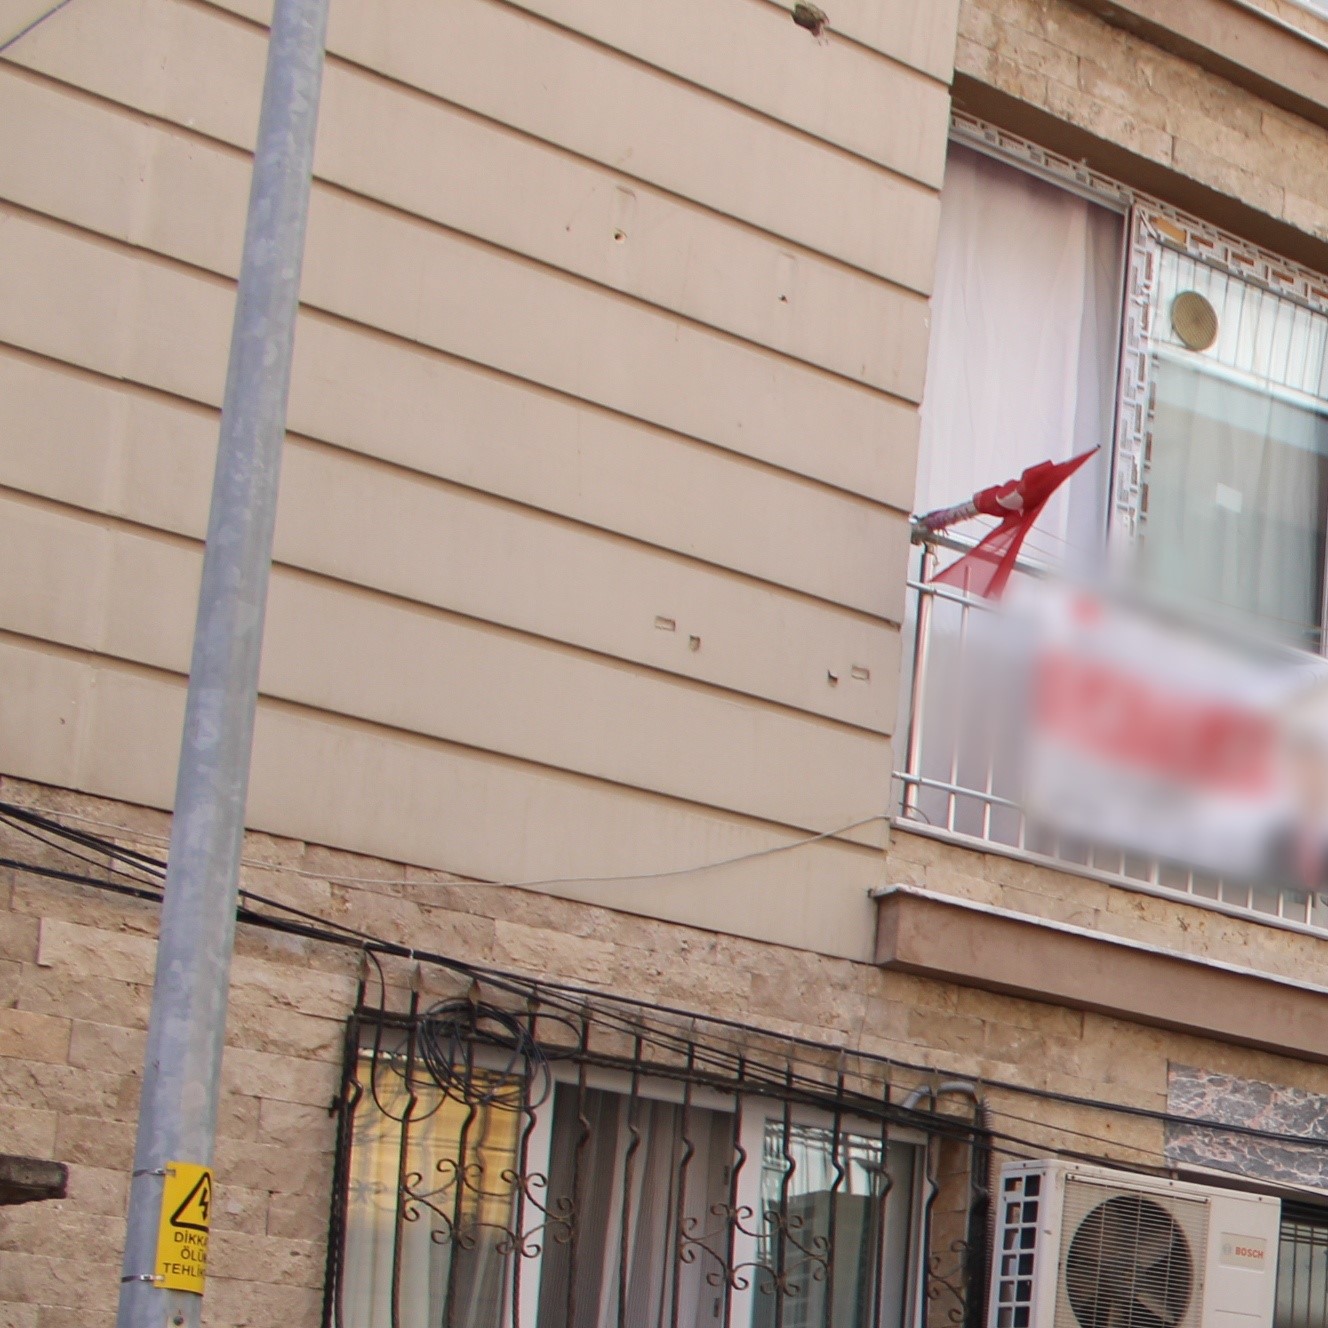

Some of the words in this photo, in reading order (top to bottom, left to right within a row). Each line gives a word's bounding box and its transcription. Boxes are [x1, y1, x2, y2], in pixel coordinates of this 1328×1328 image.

[174, 1230, 208, 1246] DİKK
[181, 1246, 206, 1263] ÖLÜ
[1235, 1246, 1264, 1259] BOSCH
